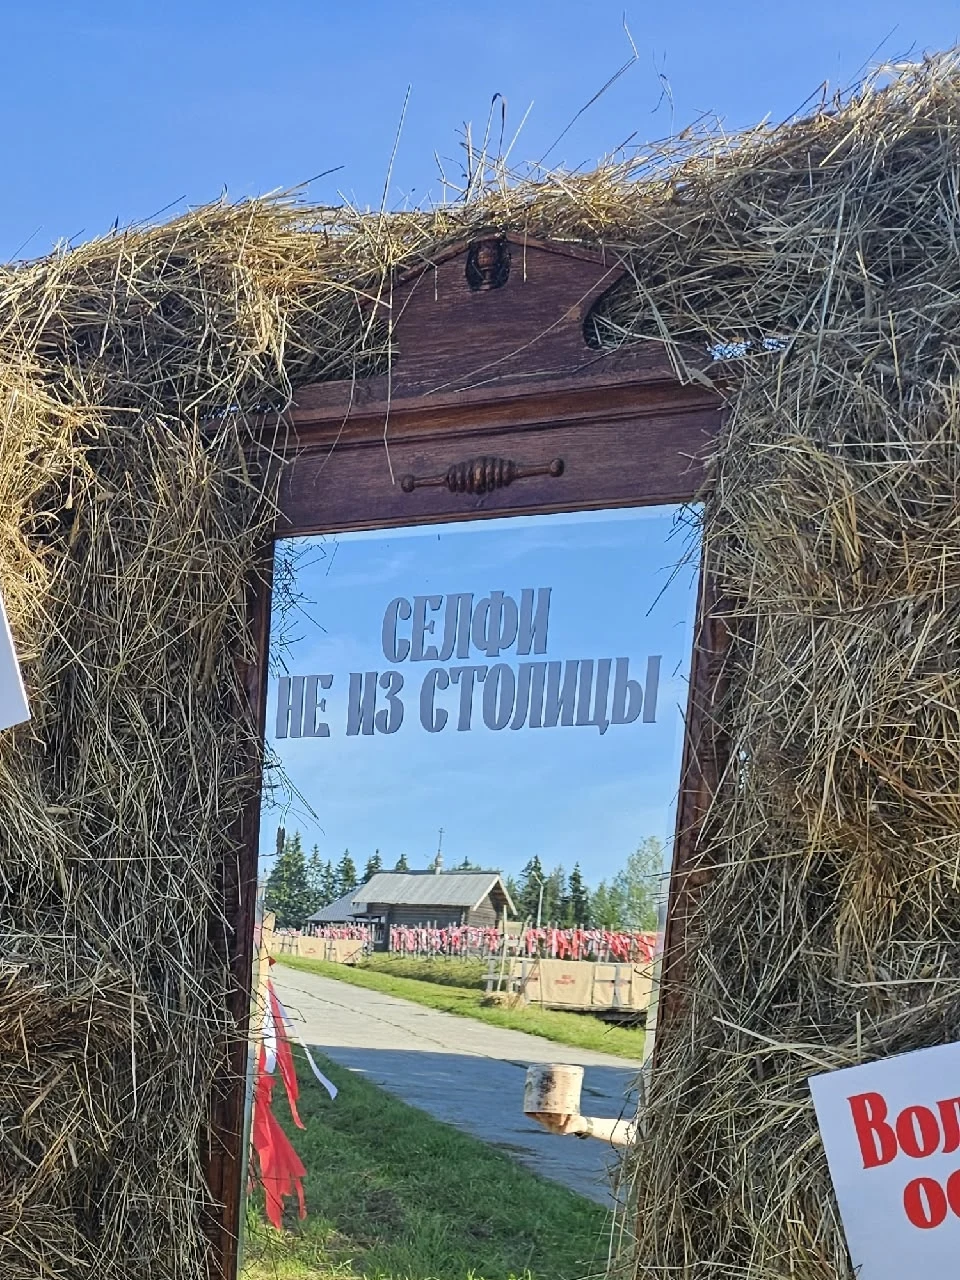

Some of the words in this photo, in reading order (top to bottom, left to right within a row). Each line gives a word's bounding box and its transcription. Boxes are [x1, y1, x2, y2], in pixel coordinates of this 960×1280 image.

[381, 586, 553, 664] СЕЛФИ
[275, 673, 334, 740] НЕ
[346, 669, 405, 737] ИЗ
[419, 654, 663, 736] СТОЛИЦЫ
